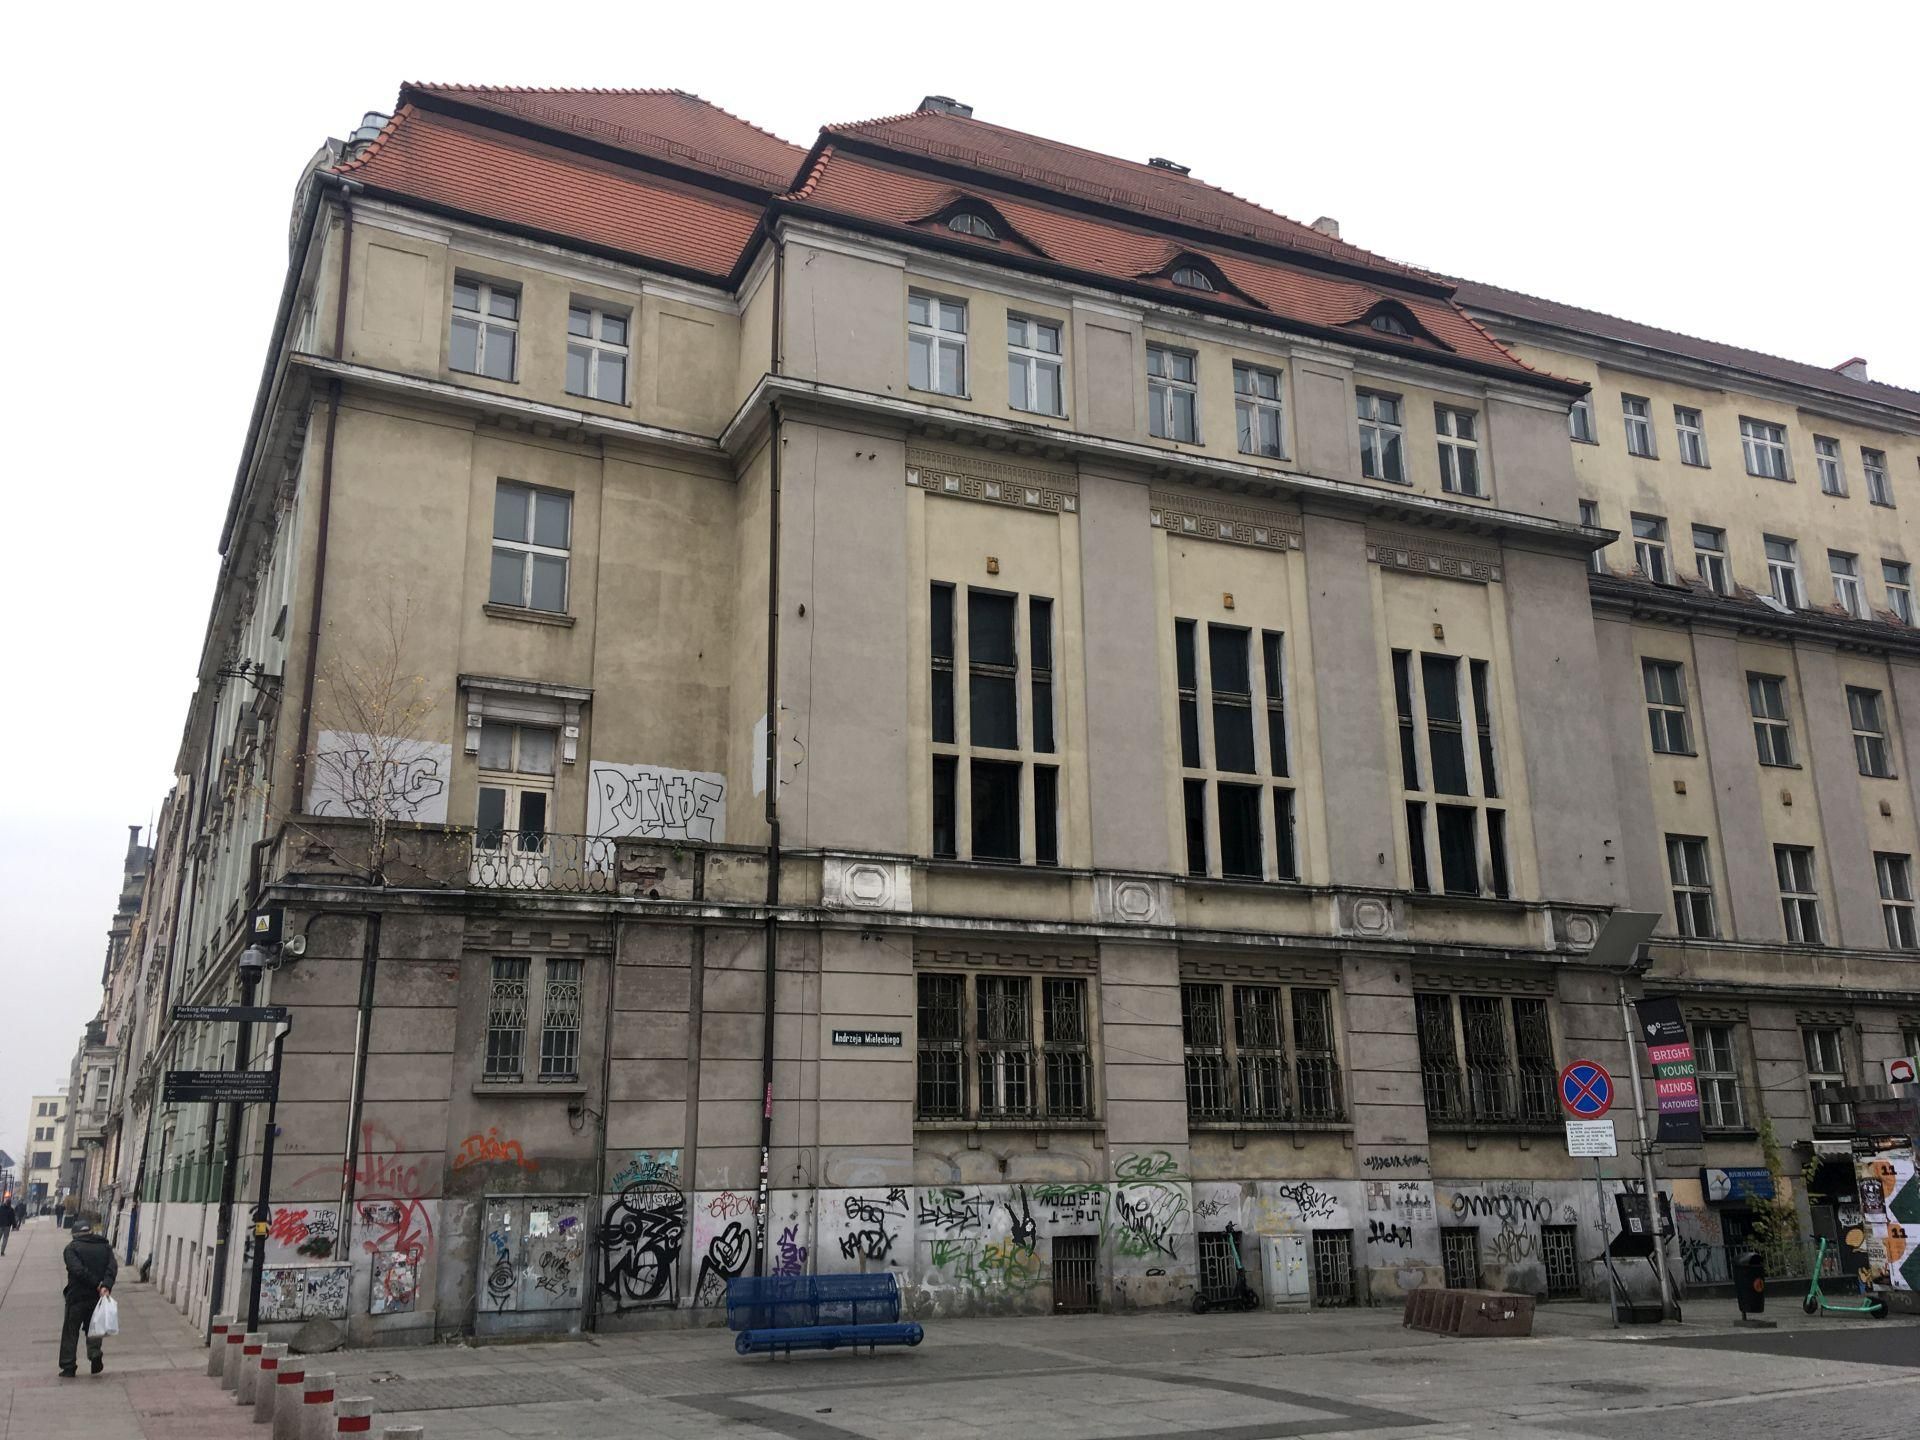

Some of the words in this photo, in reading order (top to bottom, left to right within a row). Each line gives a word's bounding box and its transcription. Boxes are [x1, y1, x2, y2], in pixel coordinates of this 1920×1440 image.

[835, 1032, 862, 1045] Andrzeja
[1653, 1047, 1691, 1061] BRIGHT
[1661, 1064, 1695, 1077] YOUNG
[1660, 1081, 1693, 1094] MINDS
[1662, 1099, 1699, 1109] KATOWICE
